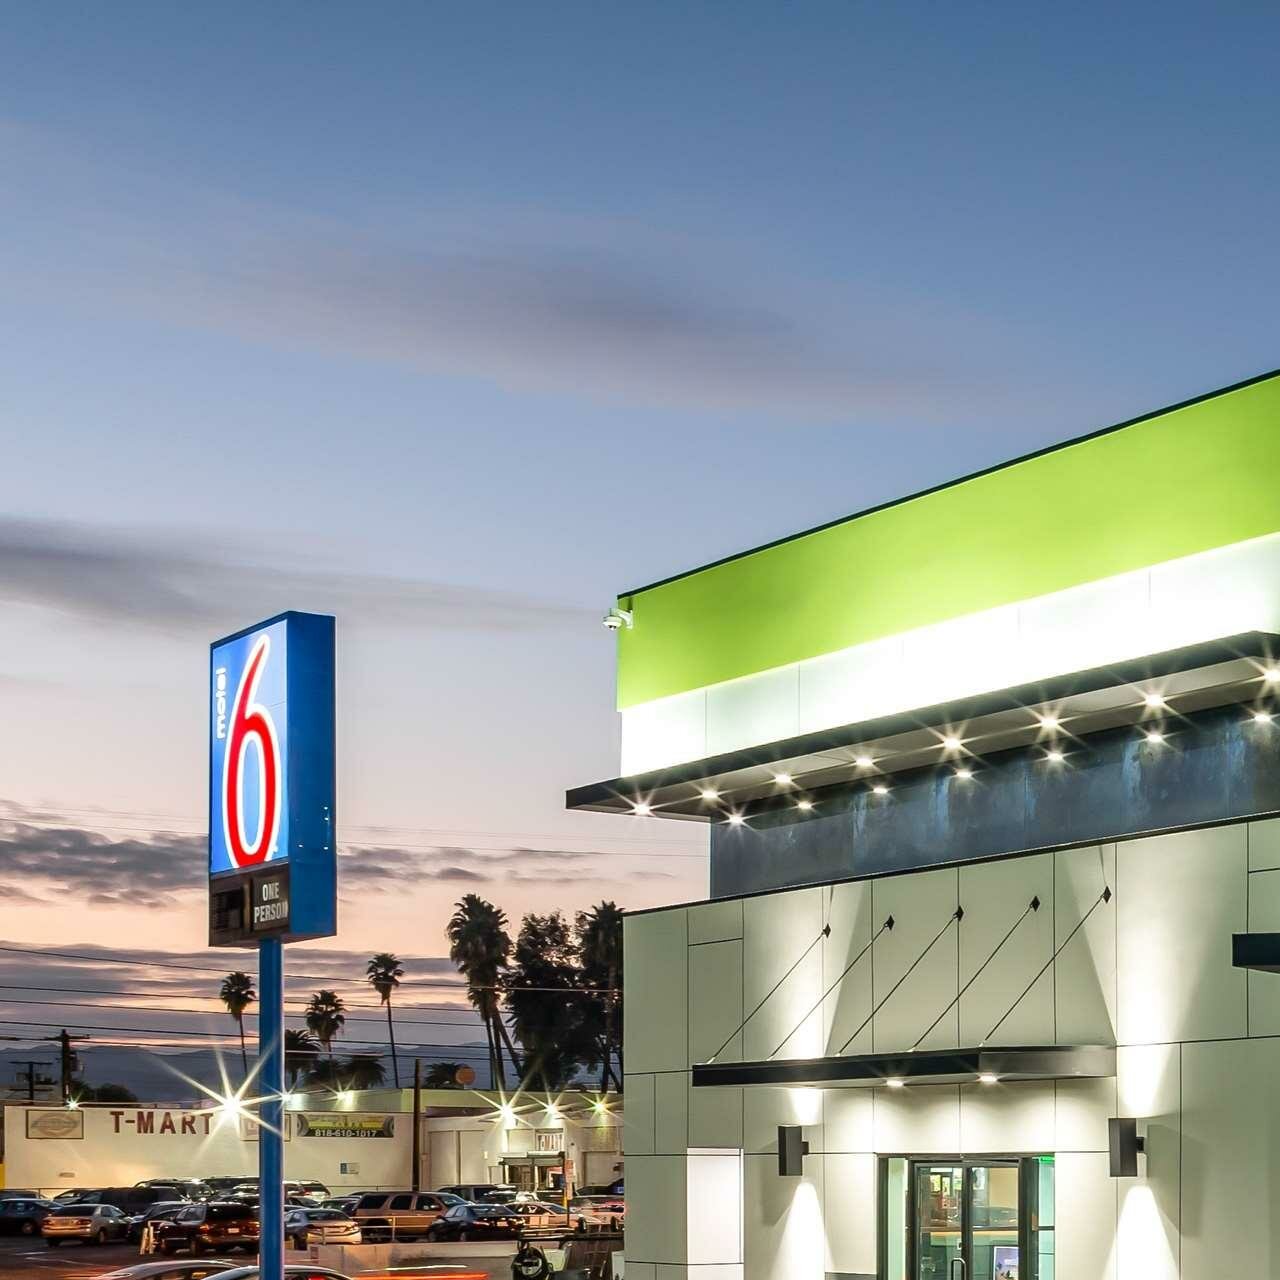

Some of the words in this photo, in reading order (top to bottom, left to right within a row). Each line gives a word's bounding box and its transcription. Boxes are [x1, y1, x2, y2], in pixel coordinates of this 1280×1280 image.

[223, 634, 282, 869] 6
[262, 882, 280, 901] ONE
[254, 900, 289, 923] PERSON
[110, 1111, 213, 1135] T-MART
